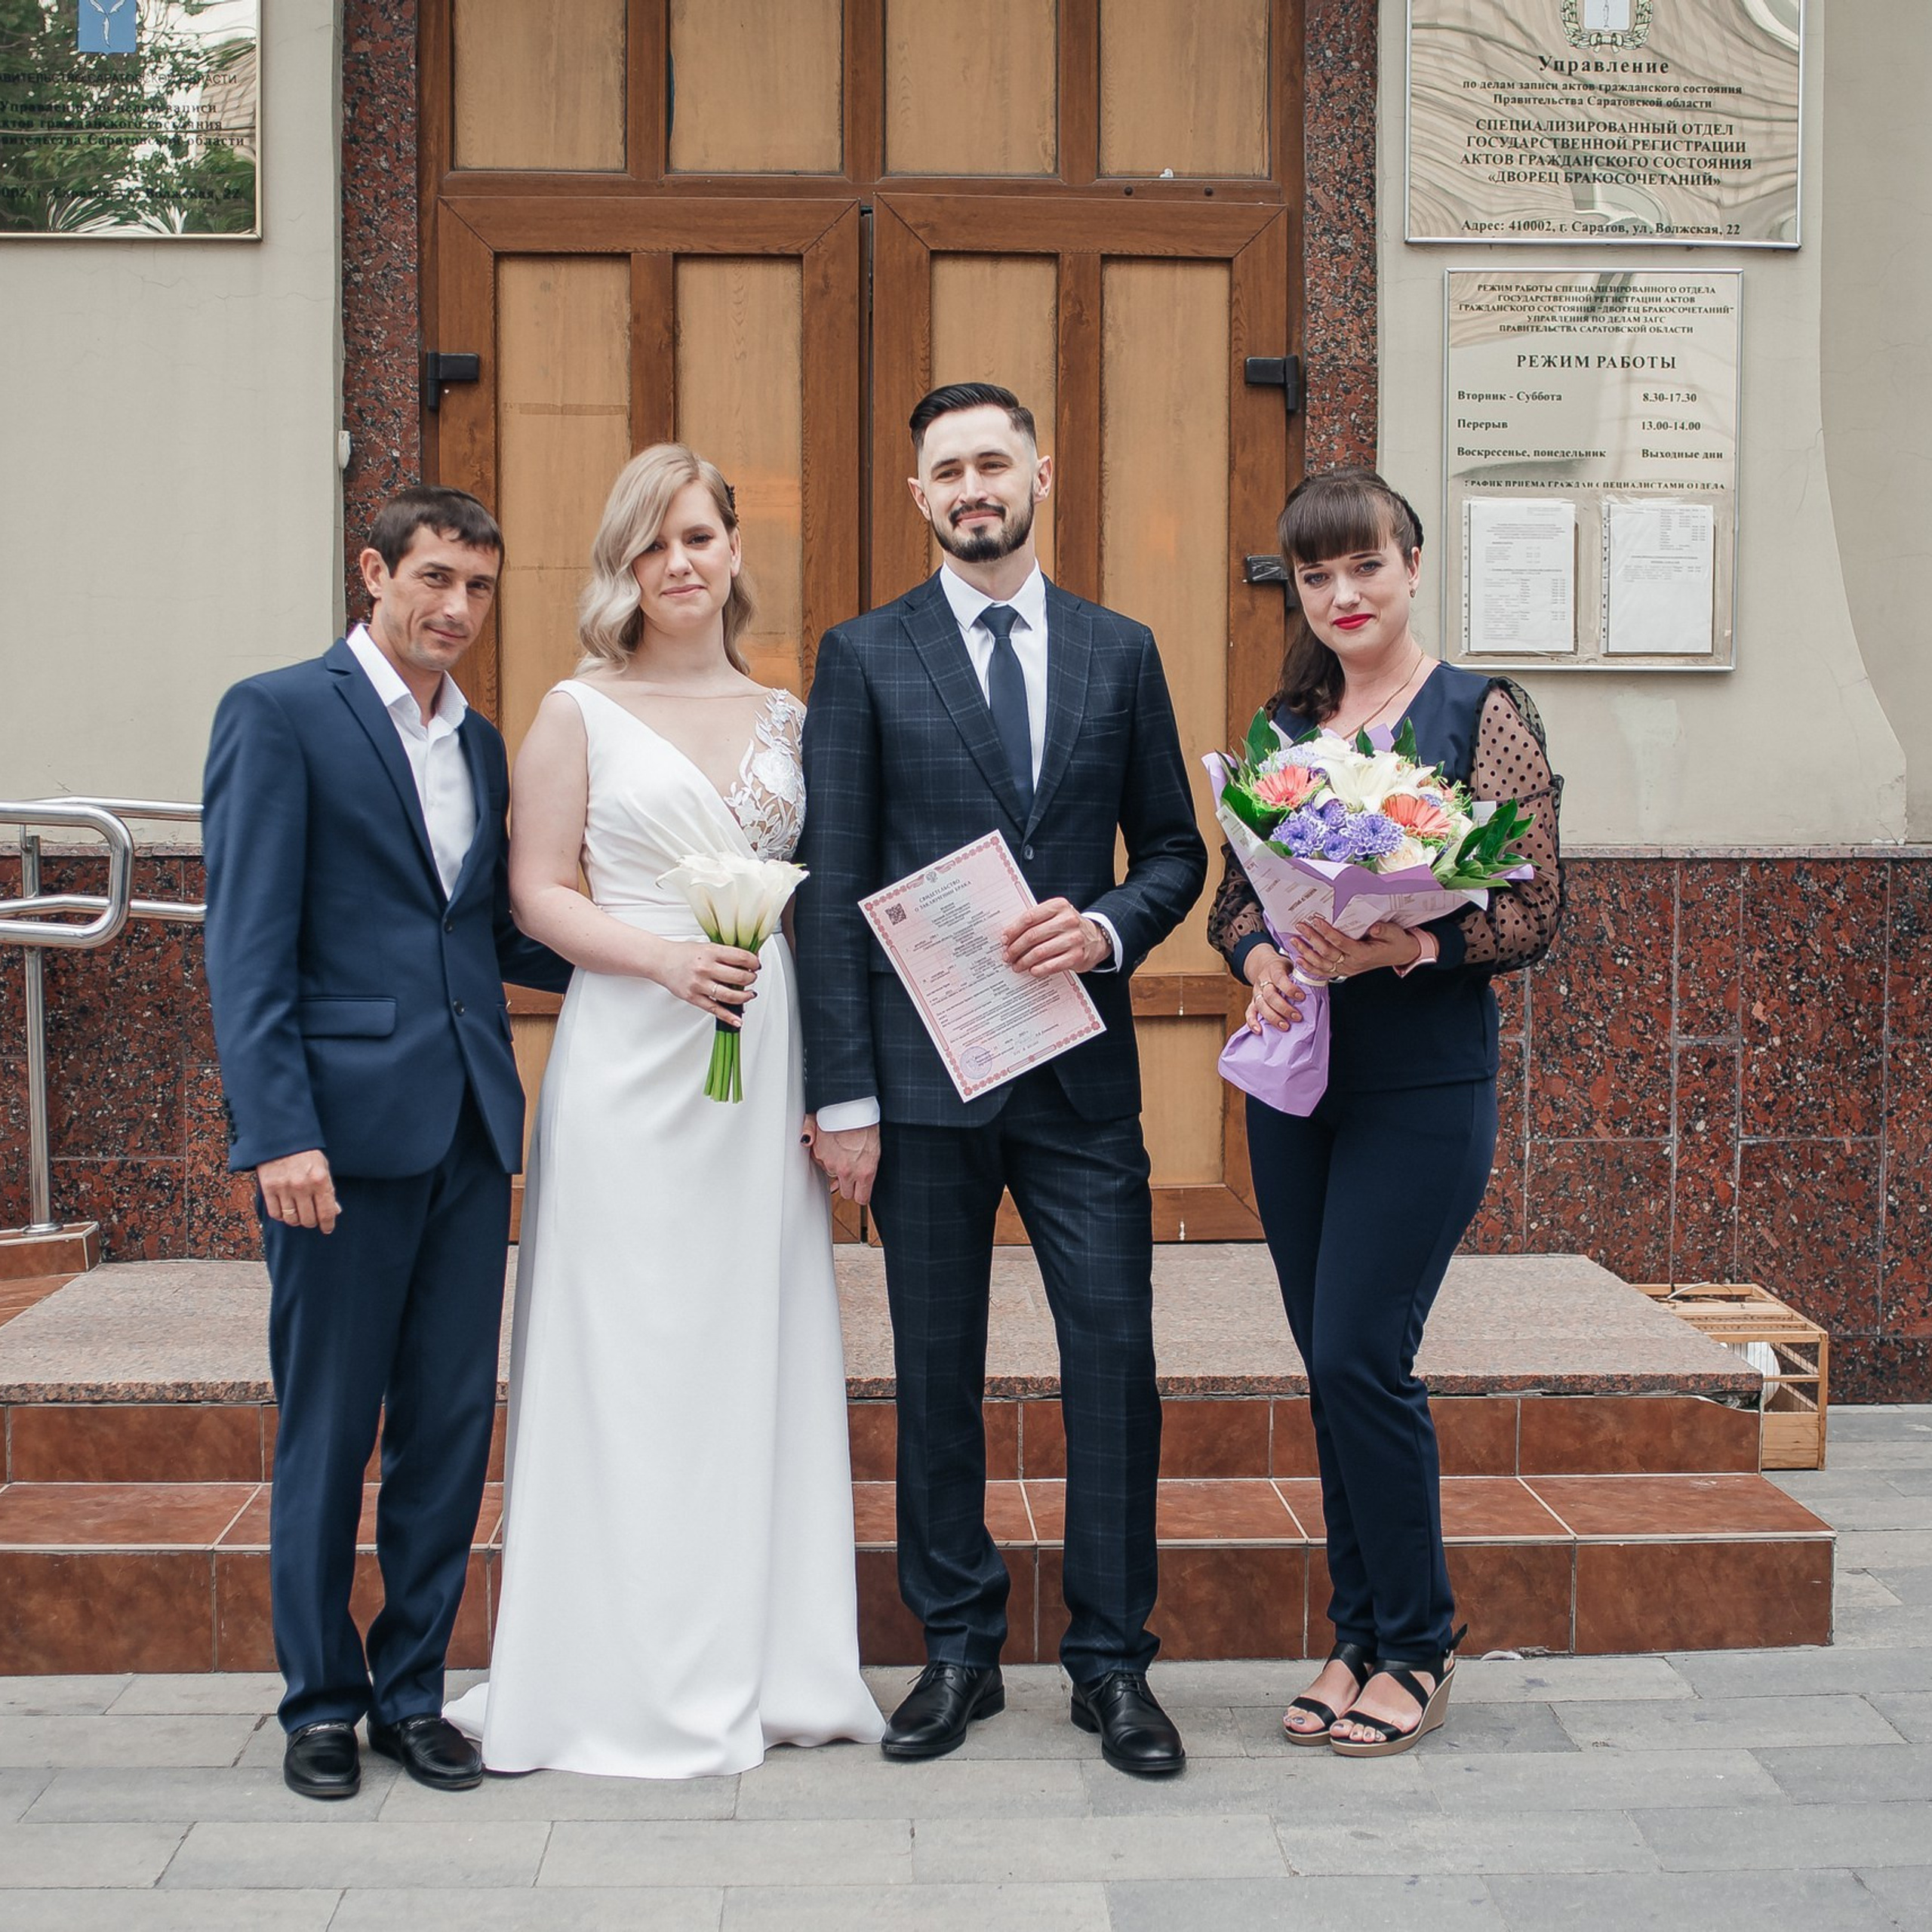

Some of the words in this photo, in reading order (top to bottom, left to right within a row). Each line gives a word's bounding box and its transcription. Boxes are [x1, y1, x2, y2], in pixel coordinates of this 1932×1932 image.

[1538, 55, 1669, 74] Управление
[0, 74, 85, 84] ВИТЕЛЬСТВО
[88, 74, 174, 85] САРАТОВСКО
[1518, 81, 1559, 91] записи
[1562, 82, 1595, 91] актов
[1598, 84, 1680, 94] гражданского
[1683, 86, 1742, 94] состояния
[1494, 94, 1583, 106] Правительства
[1587, 95, 1663, 107] Саратовской
[1666, 97, 1712, 108] области
[167, 104, 217, 113] записи
[39, 119, 143, 131] гражданского
[1476, 118, 1677, 135] СПЕЦИАЛИЗИРОВАННЫЙ
[1682, 124, 1733, 137] ОТДЕЛ
[1, 136, 81, 146] вительства
[188, 134, 245, 146] области
[1467, 135, 1627, 152] ГОСУДАРСТВЕННОЙ
[1632, 139, 1746, 154] РЕГИСТРАЦИИ
[1460, 153, 1513, 165] АКТОВ
[1519, 152, 1648, 168] ГРАЖДАНСКОГО
[1654, 155, 1751, 169] СОСТОЯНИЯ
[1488, 171, 1559, 185] «ДВОРЕЦ
[1564, 171, 1721, 186] БРАКОСОЧЕТАНИЙ»
[224, 188, 241, 199] 22
[1462, 220, 1504, 233] Адрес:
[1509, 220, 1555, 232] 410002,
[1559, 224, 1567, 233] г.
[1572, 221, 1629, 236] Саратов,
[1655, 223, 1722, 235] Волжская,
[1727, 224, 1740, 235] 22
[1555, 285, 1677, 294] СПЕЦИАЛИЗИРОВАННОГО
[1498, 294, 1591, 303] ГОСУДАРСТВЕННОЙ
[1594, 295, 1661, 303] РЕГИСТРАЦИИ
[1527, 315, 1589, 324] УПРАВЛЕНИЯ
[1580, 325, 1646, 333] САРАТОВСКОЙ
[1518, 355, 1589, 368] РЕЖИМ
[1597, 355, 1677, 369] РАБОТЫ
[1458, 391, 1506, 402] Вторник
[1517, 392, 1561, 403] Суббота
[1643, 393, 1697, 402] 8.30-17.30
[1458, 419, 1508, 430] Перерыв
[1642, 421, 1700, 430] 13.00-14.00
[1457, 447, 1530, 458] Воскресенье,
[1642, 449, 1700, 459] Выходные
